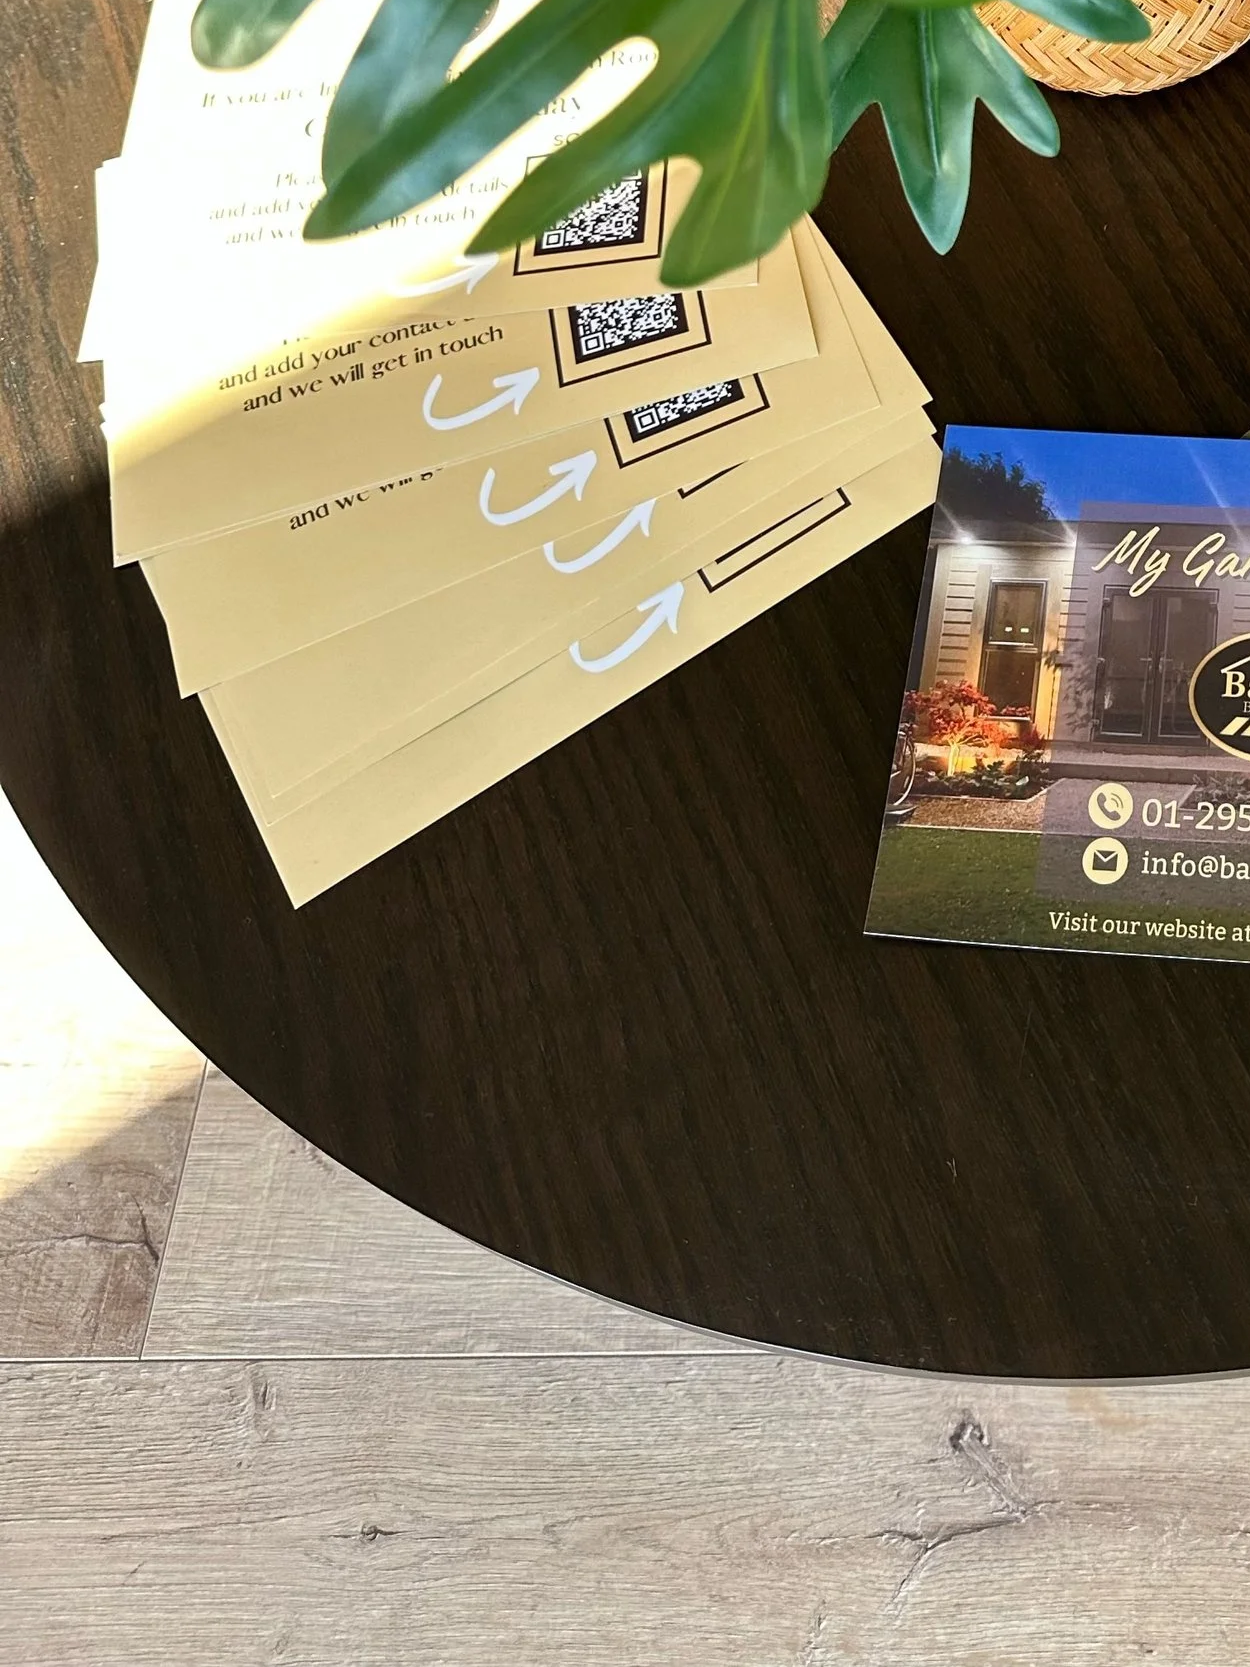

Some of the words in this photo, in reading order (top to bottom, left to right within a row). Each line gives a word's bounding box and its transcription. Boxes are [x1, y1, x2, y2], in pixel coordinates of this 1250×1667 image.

[219, 365, 258, 391] and
[264, 352, 304, 379] add
[310, 339, 363, 370] your
[243, 385, 282, 412] and
[288, 378, 323, 398] we
[329, 362, 365, 387] will
[371, 354, 408, 380] get
[414, 347, 433, 364] in
[440, 324, 504, 356] touch
[1091, 525, 1172, 598] My
[1048, 910, 1099, 934] Visit
[1102, 918, 1142, 937] our
[1144, 918, 1228, 943] website
